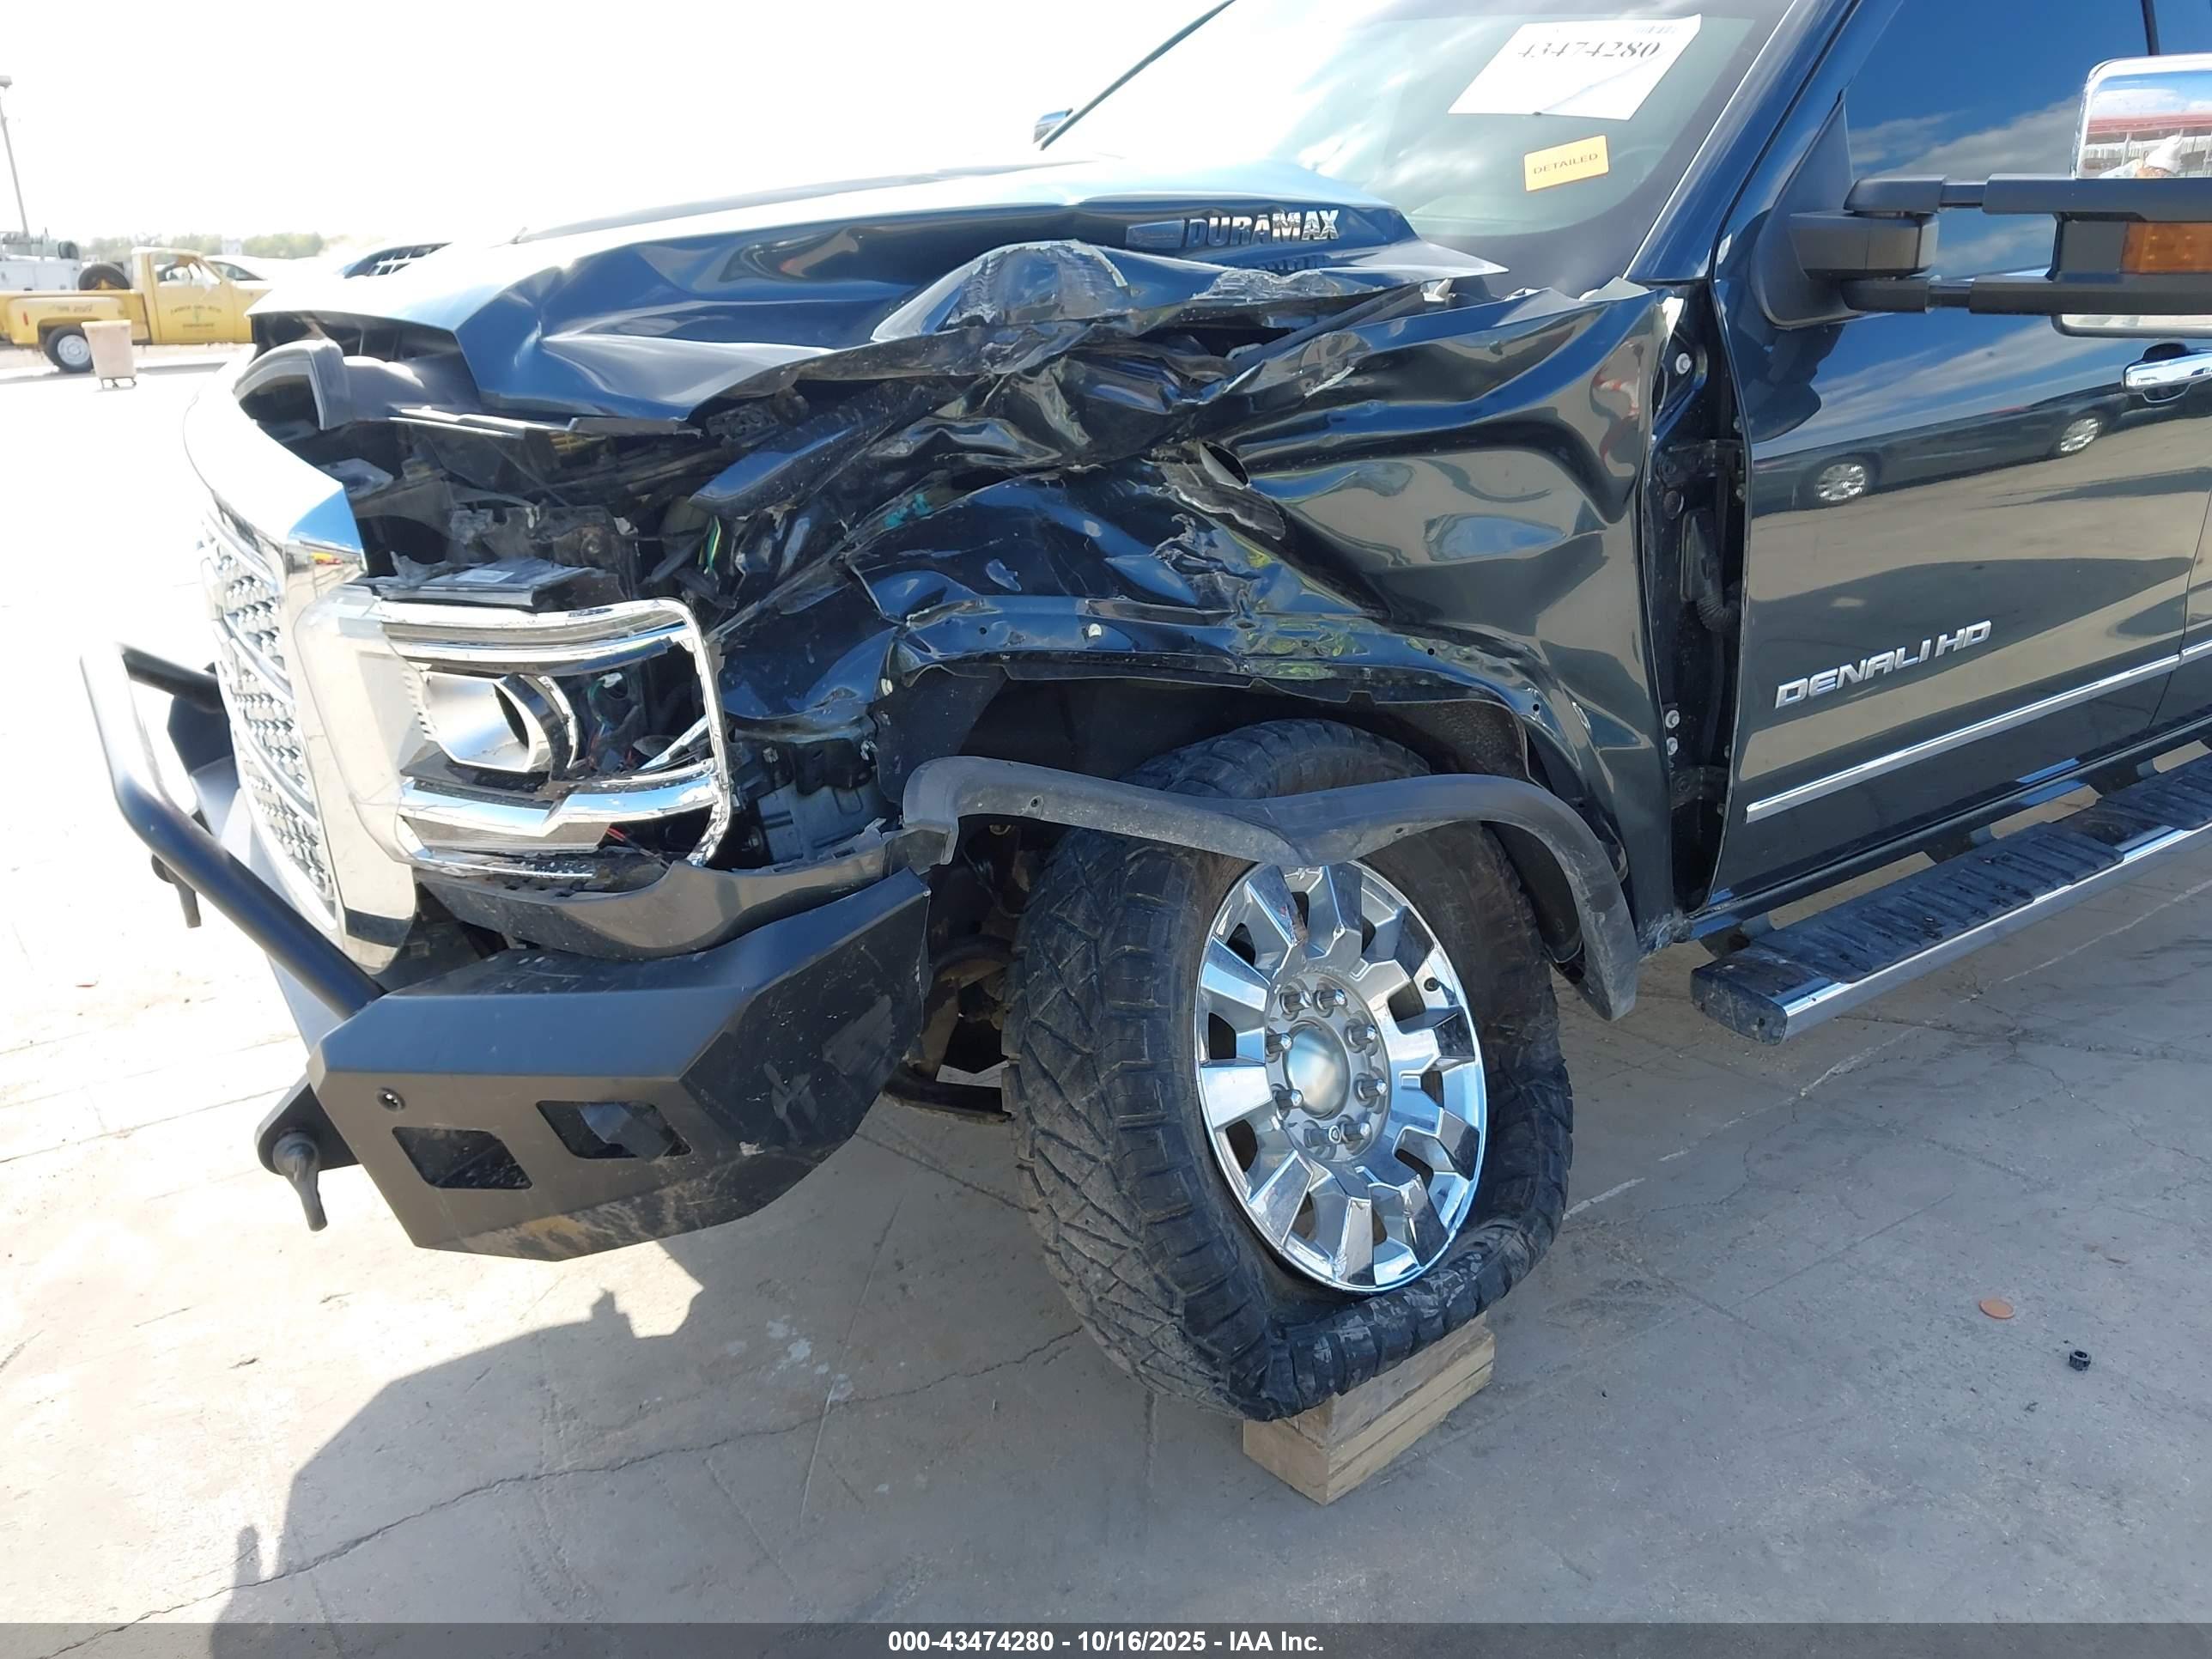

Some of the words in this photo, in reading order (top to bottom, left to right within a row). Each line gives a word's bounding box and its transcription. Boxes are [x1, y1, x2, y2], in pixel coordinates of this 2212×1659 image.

[1532, 152, 1599, 175] DETAILED
[1185, 209, 1340, 248] DURAMAX
[1774, 639, 1932, 709] DENALI
[1934, 619, 1992, 658] HD
